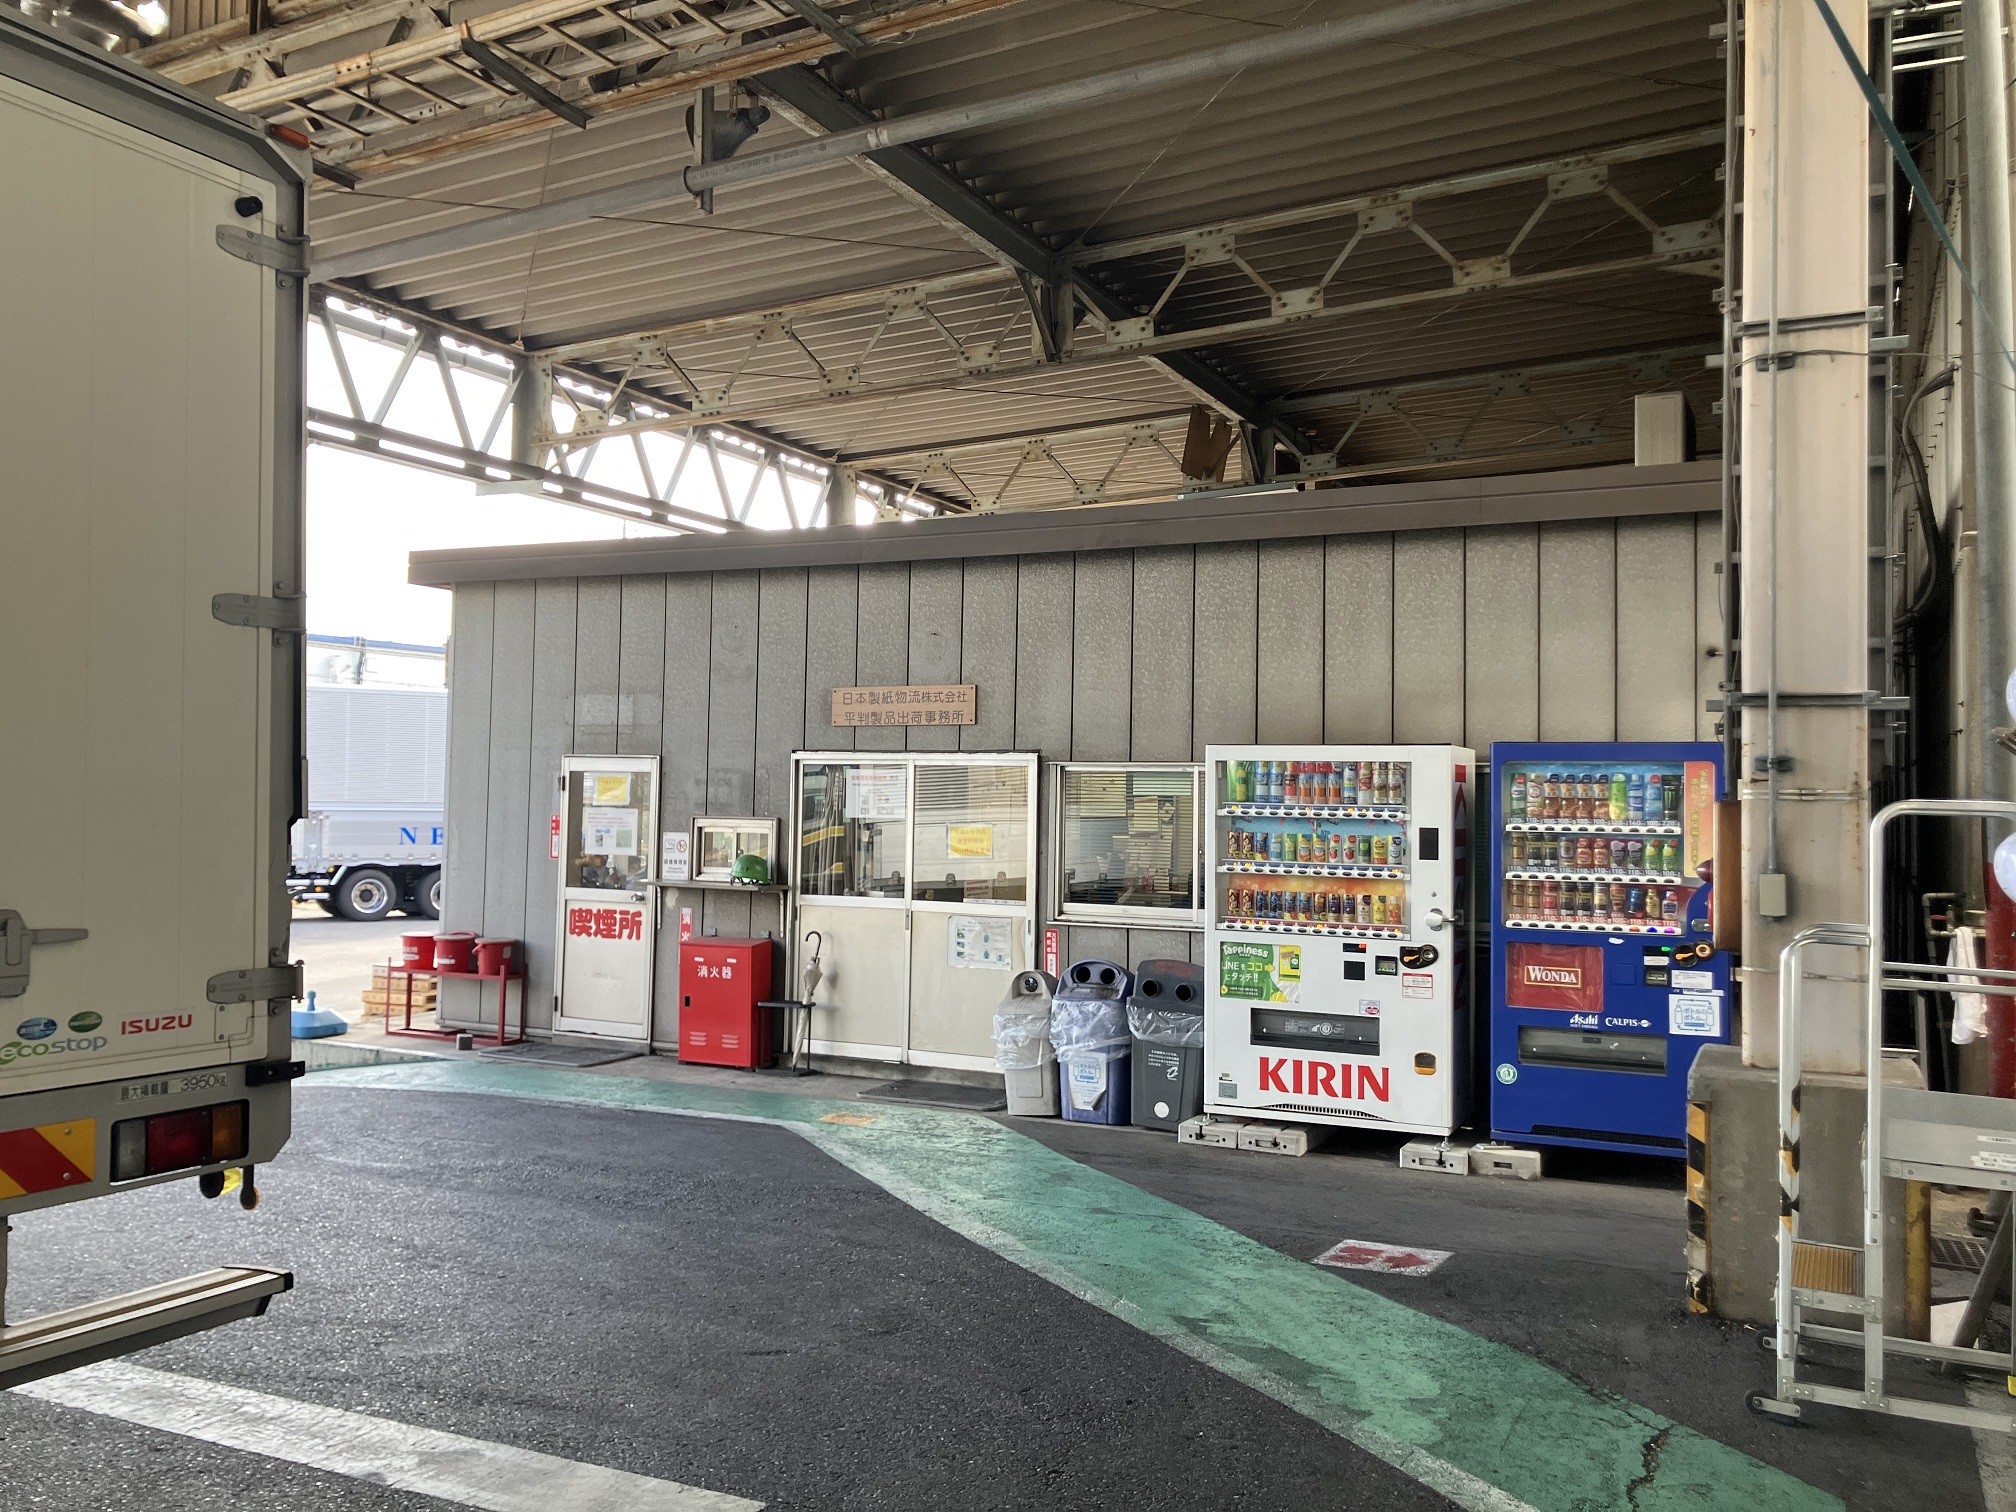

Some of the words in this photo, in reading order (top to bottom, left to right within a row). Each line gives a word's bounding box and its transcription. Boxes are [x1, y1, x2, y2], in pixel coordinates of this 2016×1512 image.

[842, 690, 968, 705] 日本製紙物流株式会社
[844, 709, 965, 725] 平判製品出荷事務所
[569, 907, 642, 940] 喫煙所
[1222, 943, 1269, 958] Tappiness
[697, 964, 733, 980] 消火器
[1526, 965, 1578, 983] WONDA
[121, 1014, 193, 1035] ISUZU
[1569, 1013, 1599, 1025] Asahi
[1605, 1017, 1638, 1027] CALPIS
[0, 1036, 107, 1065] ecostop
[1258, 1056, 1390, 1103] KIRIN
